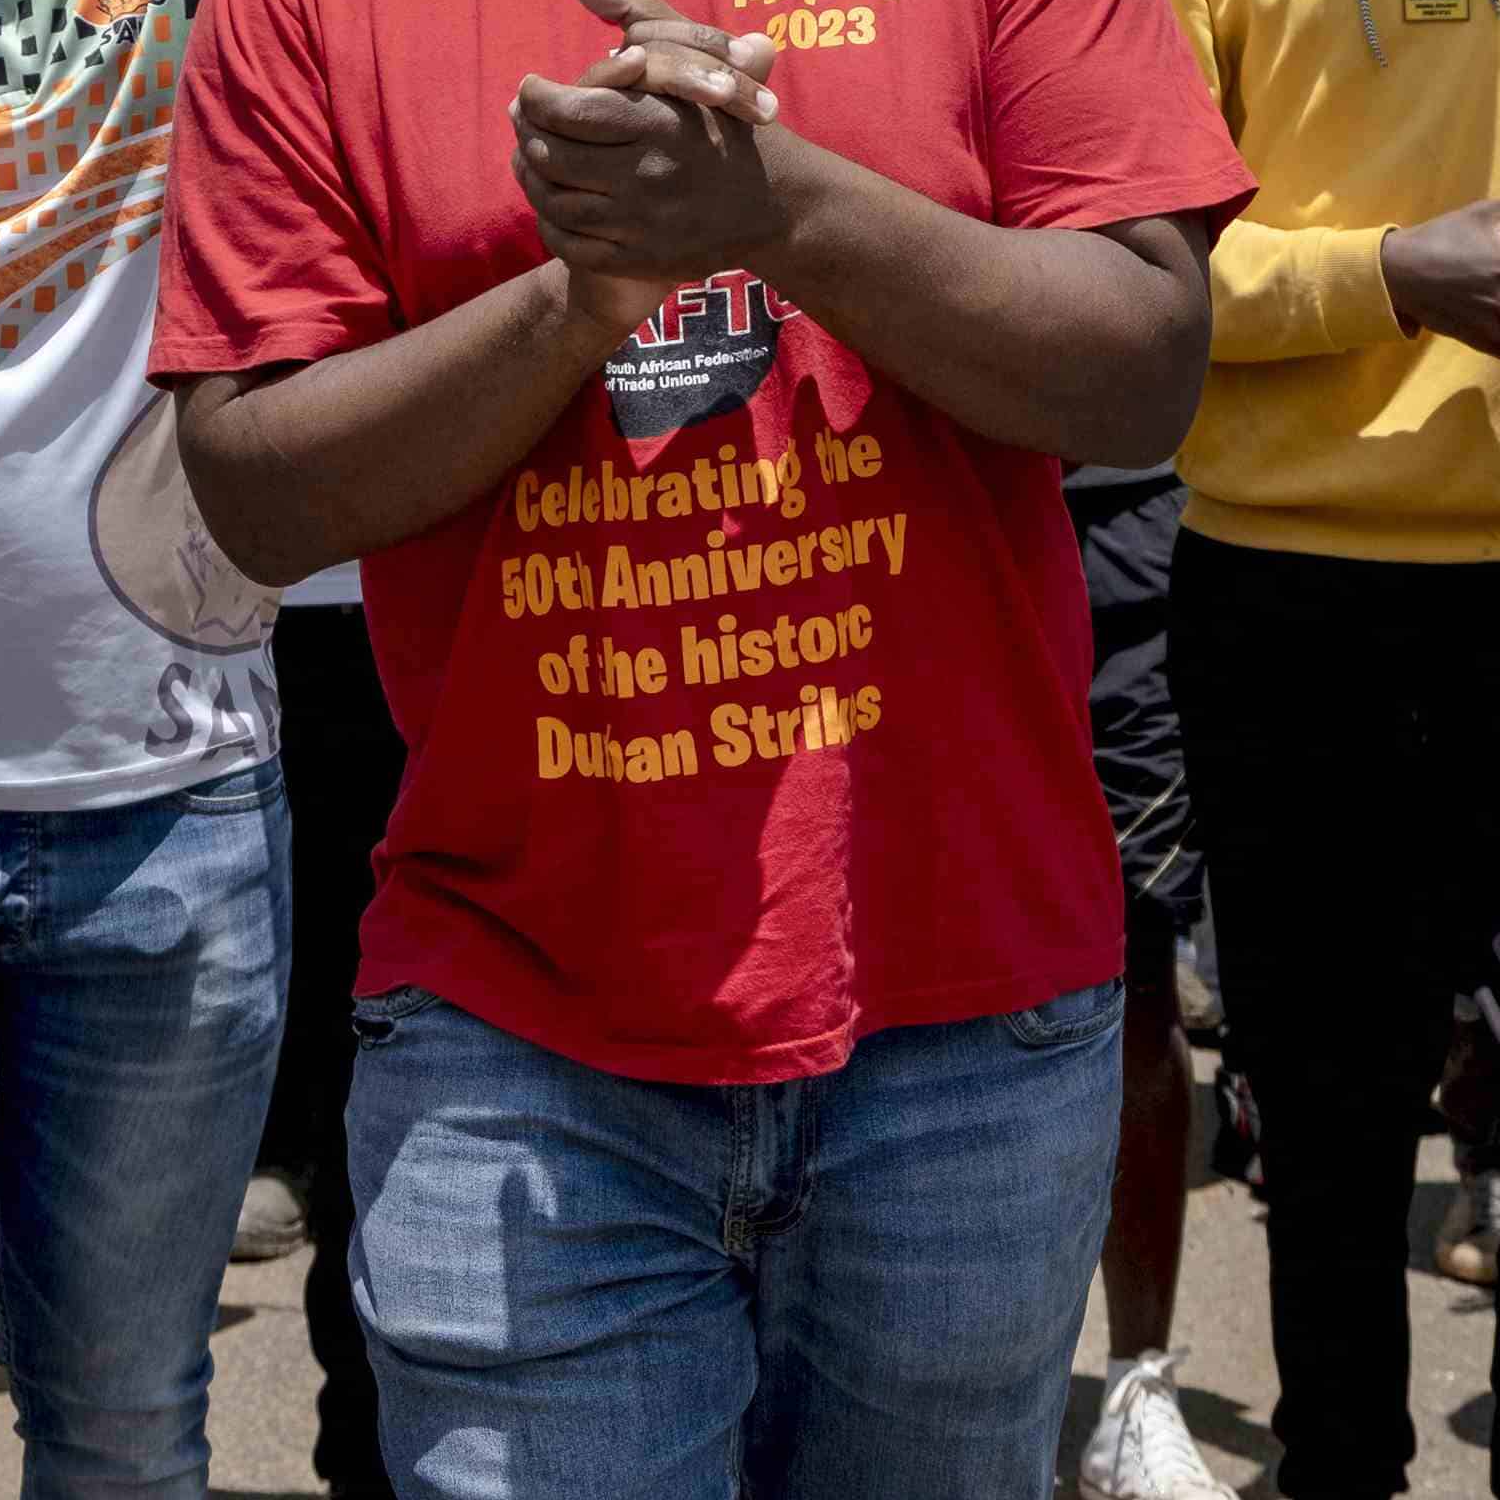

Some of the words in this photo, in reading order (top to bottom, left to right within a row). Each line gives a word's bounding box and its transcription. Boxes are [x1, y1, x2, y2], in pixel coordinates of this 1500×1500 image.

[766, 6, 877, 52] 2023
[604, 377, 616, 392] of
[617, 375, 657, 392] Trade
[658, 372, 711, 389] Unions
[605, 361, 636, 375] South
[638, 357, 692, 375] African
[515, 438, 807, 532] Celebrating
[537, 633, 591, 696] of
